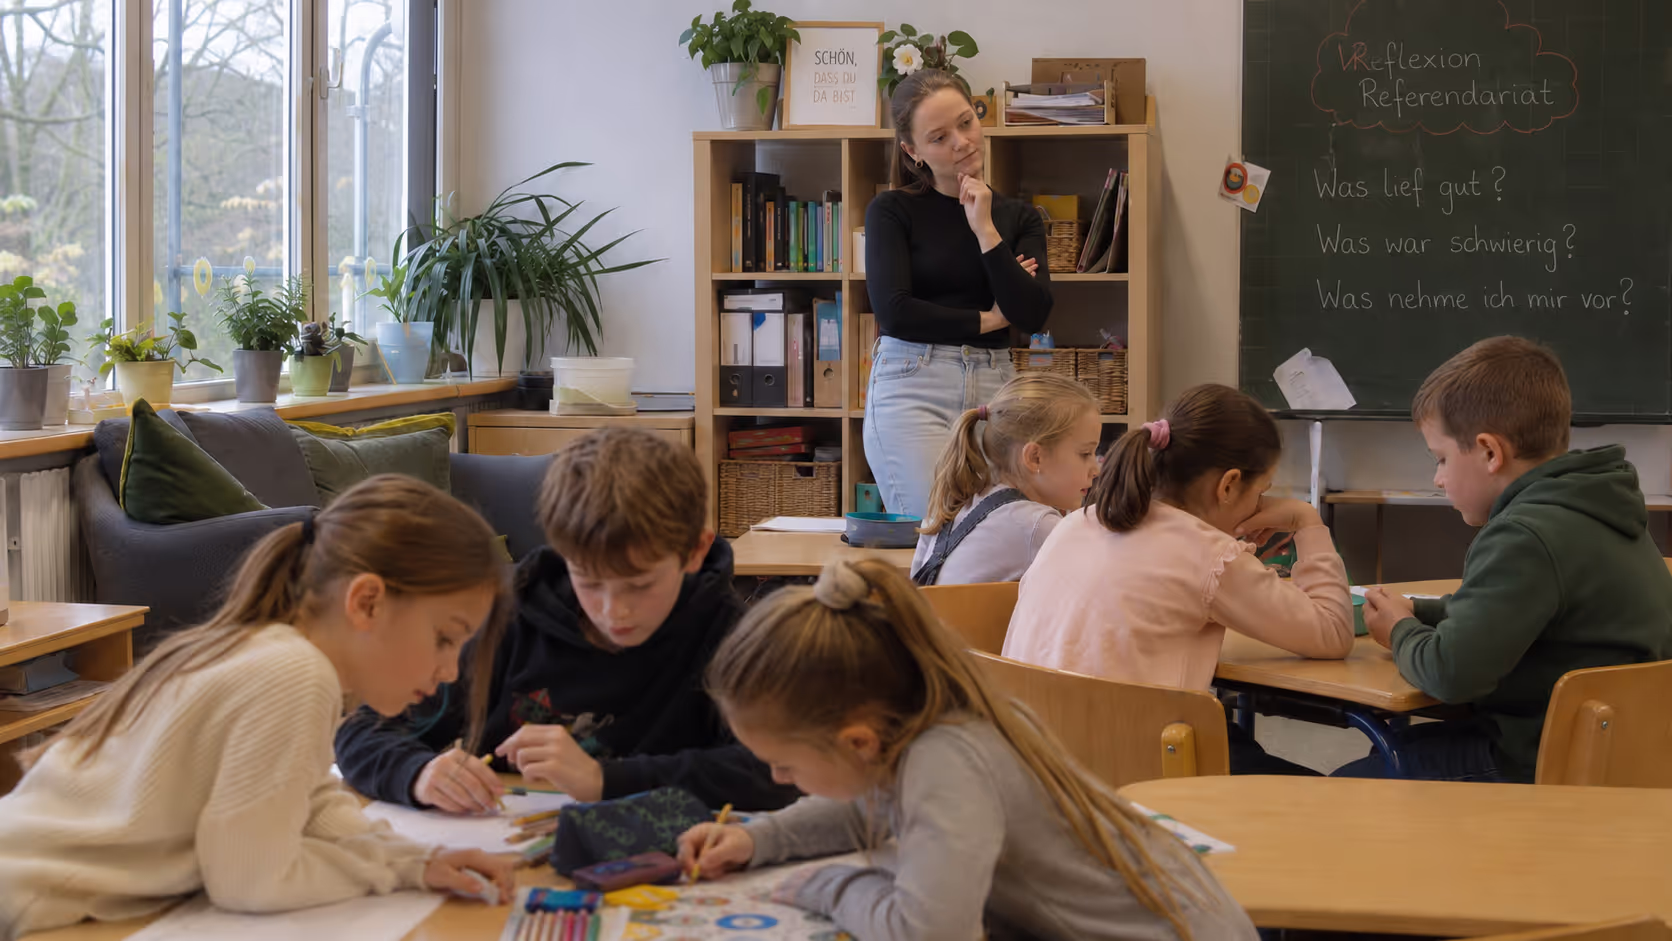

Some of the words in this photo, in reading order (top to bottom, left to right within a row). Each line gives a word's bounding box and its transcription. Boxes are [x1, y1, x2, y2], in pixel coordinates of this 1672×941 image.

[814, 48, 857, 67] SCHÖN,
[813, 89, 828, 103] DA
[833, 89, 856, 103] BIST
[814, 71, 839, 84] DASS
[843, 71, 856, 84] DU
[1359, 77, 1555, 118] Referendariat
[1313, 167, 1369, 200] Was
[1383, 167, 1423, 208] lief
[1316, 223, 1370, 255] Was
[1385, 236, 1432, 255] war
[1450, 223, 1576, 273] schwierig?
[1316, 278, 1373, 310] Was
[1388, 280, 1469, 310] nehme
[1483, 280, 1515, 309] ich
[1527, 287, 1568, 309] mir
[1581, 277, 1634, 315] vor?
